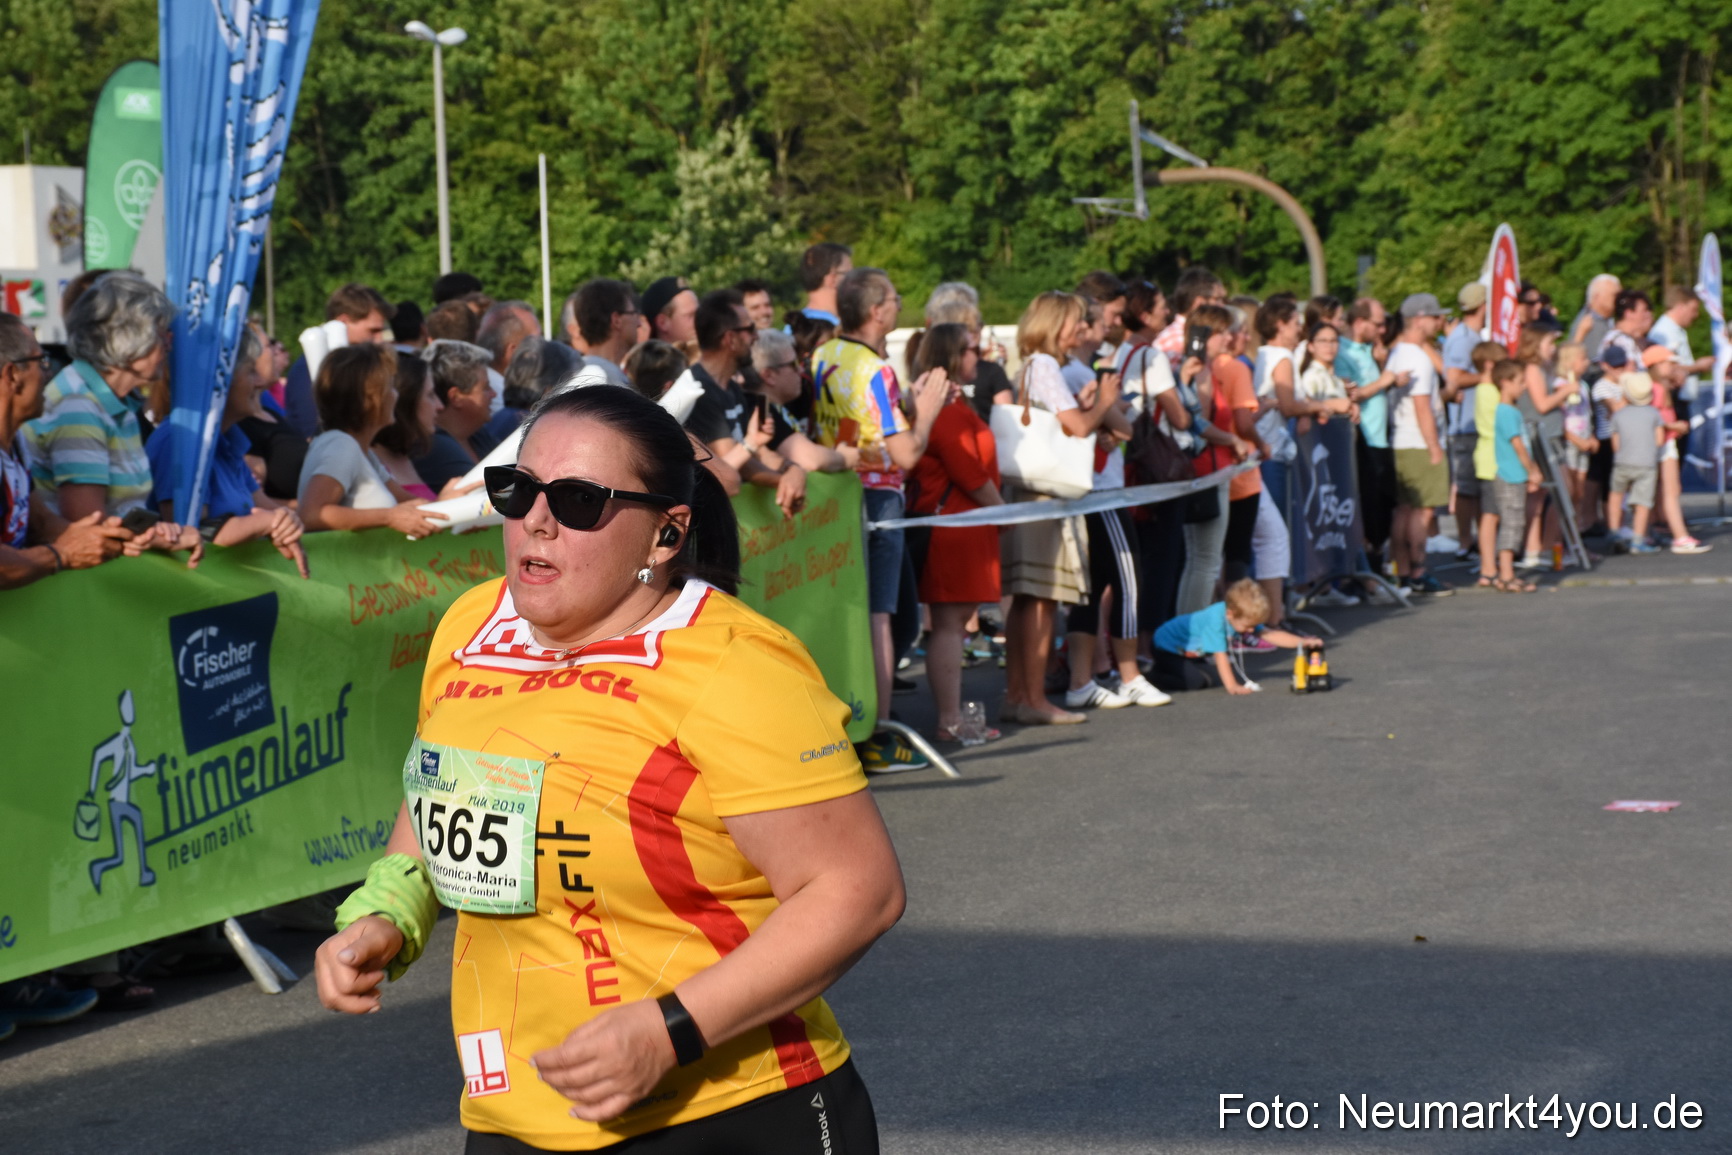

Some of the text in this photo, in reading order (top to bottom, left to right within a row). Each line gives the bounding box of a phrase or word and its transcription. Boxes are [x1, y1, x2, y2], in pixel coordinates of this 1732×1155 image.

[193, 640, 257, 679] Fischer
[202, 663, 252, 690] AUTOMOBILE
[156, 681, 353, 838] firmenlauf
[491, 798, 526, 815] 2019
[167, 808, 255, 872] neumarkt
[413, 797, 509, 868] 1565
[469, 885, 501, 899] GmbH
[818, 1110, 833, 1155] eebok
